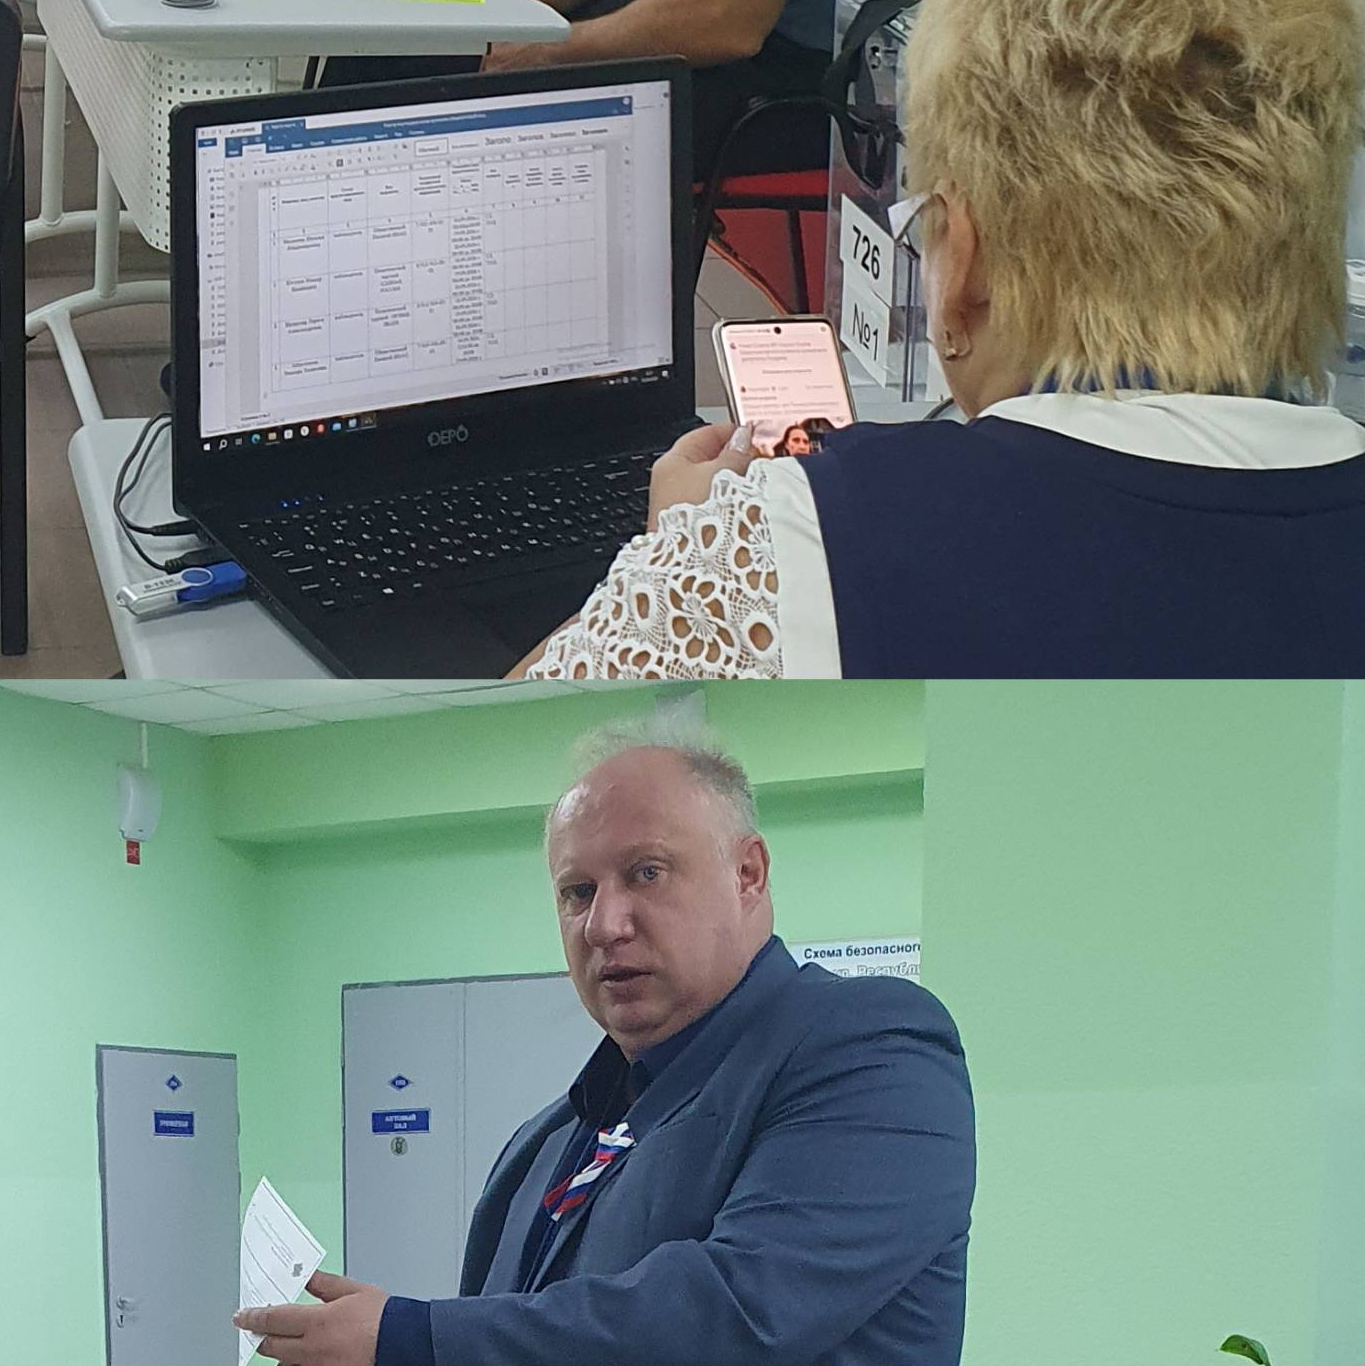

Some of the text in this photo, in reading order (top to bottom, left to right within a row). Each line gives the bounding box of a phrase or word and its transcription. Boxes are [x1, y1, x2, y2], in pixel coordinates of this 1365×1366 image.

[852, 225, 882, 281] 726
[427, 423, 469, 447] DEPO
[804, 947, 842, 959] Схема
